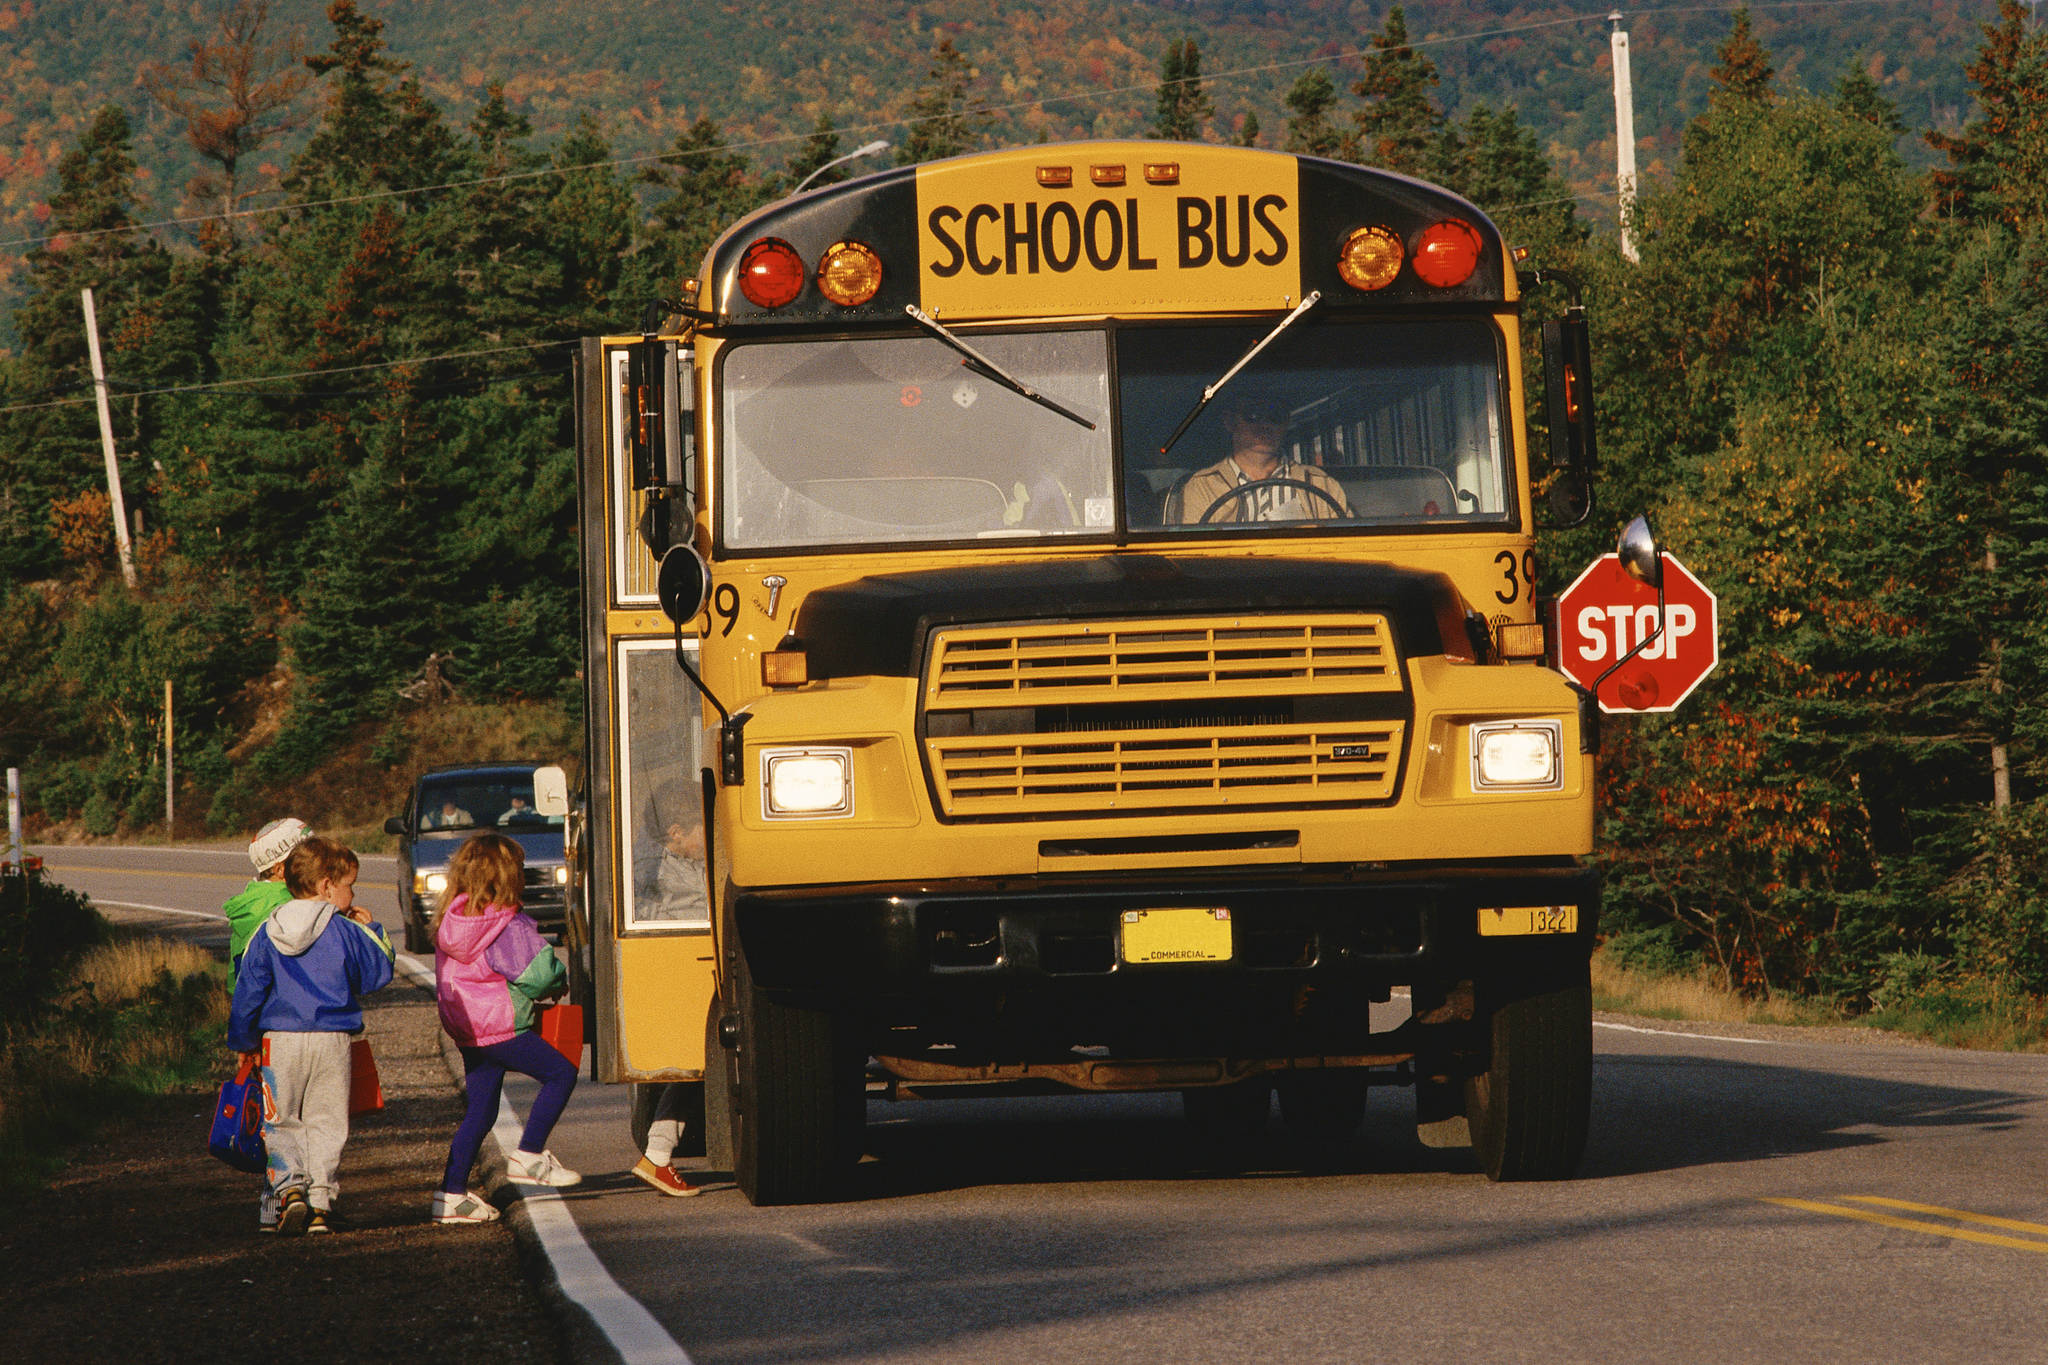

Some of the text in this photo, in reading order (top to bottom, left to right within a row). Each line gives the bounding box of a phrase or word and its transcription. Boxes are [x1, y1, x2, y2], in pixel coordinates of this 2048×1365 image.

[928, 194, 1289, 277] SCHOOL BUS
[1494, 549, 1535, 604] 39
[1577, 603, 1697, 662] STOP
[1150, 950, 1206, 960] COMMERCIAL
